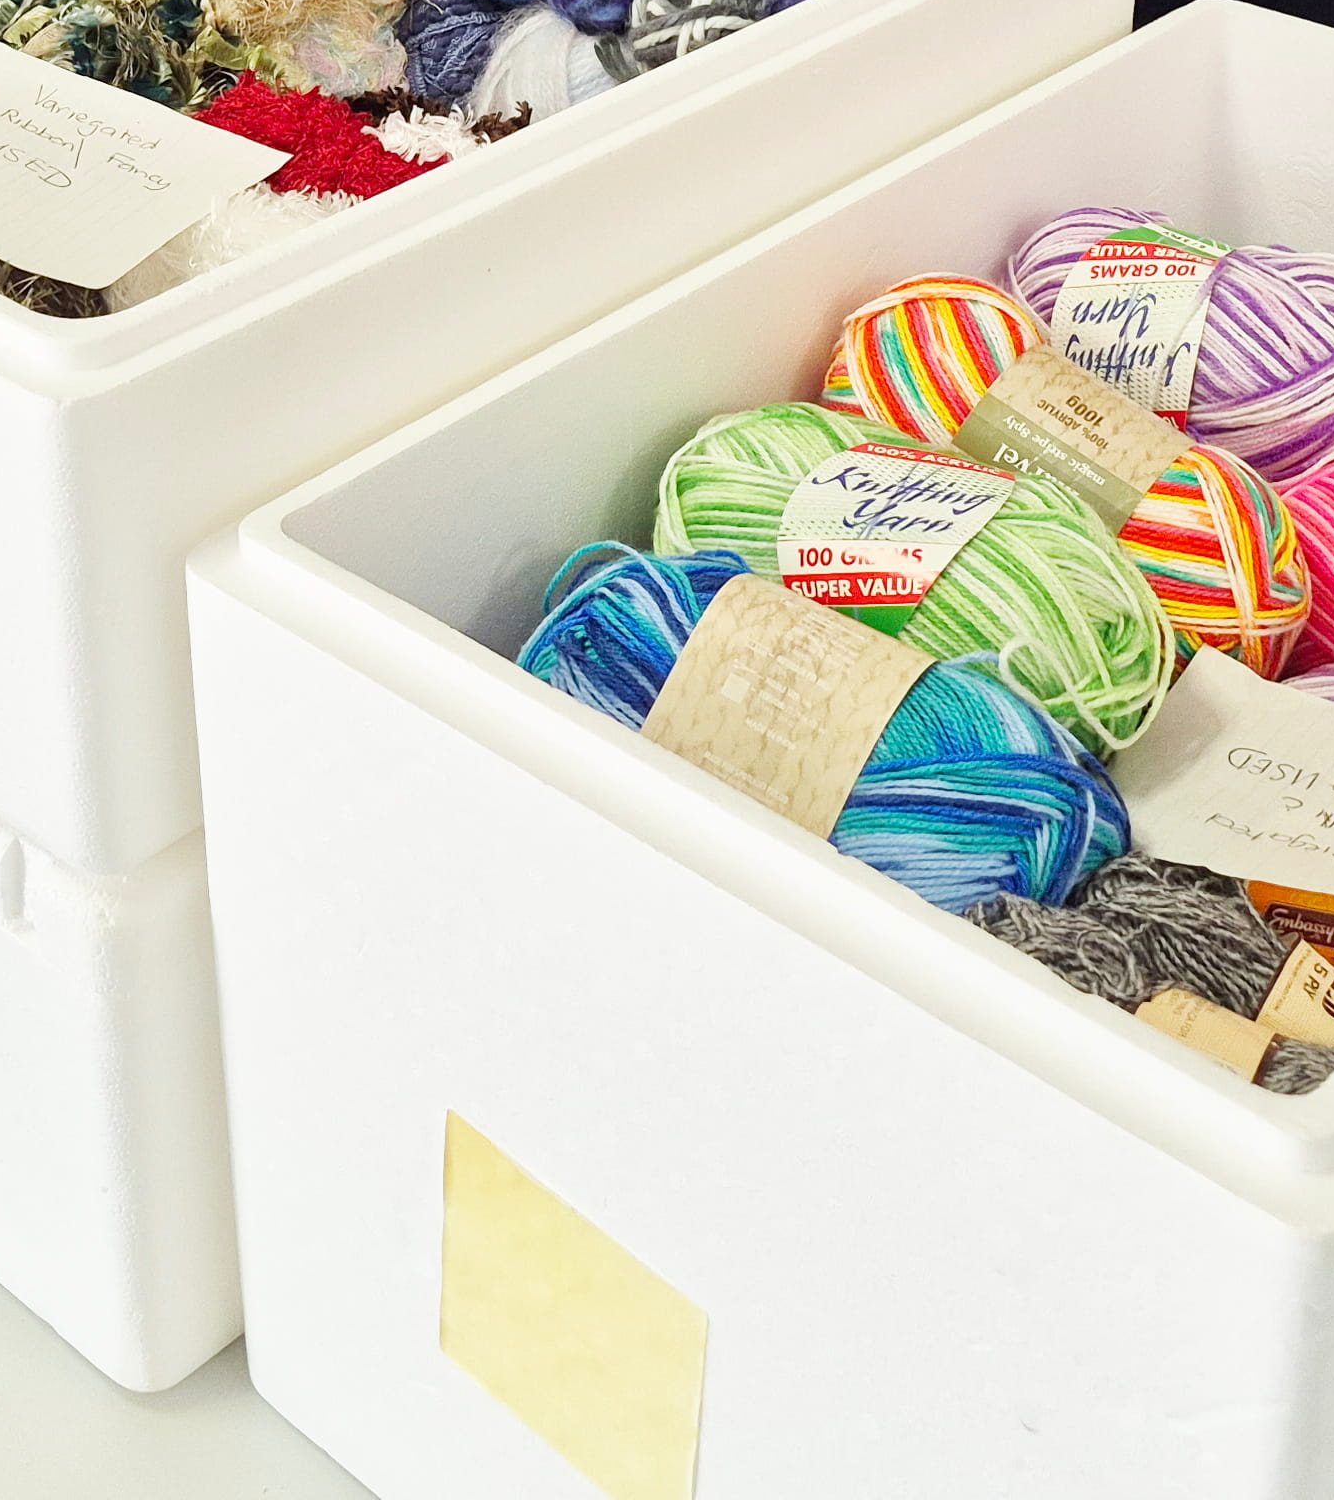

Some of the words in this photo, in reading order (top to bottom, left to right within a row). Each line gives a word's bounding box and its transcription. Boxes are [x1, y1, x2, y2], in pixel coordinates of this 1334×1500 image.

[34, 83, 162, 152] Variegated
[106, 151, 172, 191] Fancy
[1089, 244, 1147, 257] VALUE
[1090, 264, 1158, 279] GRAMS
[1165, 264, 1196, 277] 100
[1070, 293, 1156, 339] Yarn
[1036, 397, 1080, 431] ACRYLIC
[1064, 392, 1105, 429] 100g
[1001, 413, 1030, 439] 8ply
[1080, 426, 1109, 451] 100%
[866, 443, 917, 462] 100%
[921, 451, 1007, 477] ACRYLIC
[1031, 433, 1068, 462] stripe
[1068, 459, 1106, 487] magic
[811, 462, 998, 517] Knitting
[842, 497, 955, 534] Yarn
[797, 547, 833, 568] 100
[790, 577, 853, 599] SUPER
[857, 577, 925, 598] VALUE
[1227, 747, 1321, 790] USED
[1313, 962, 1329, 979] 5
